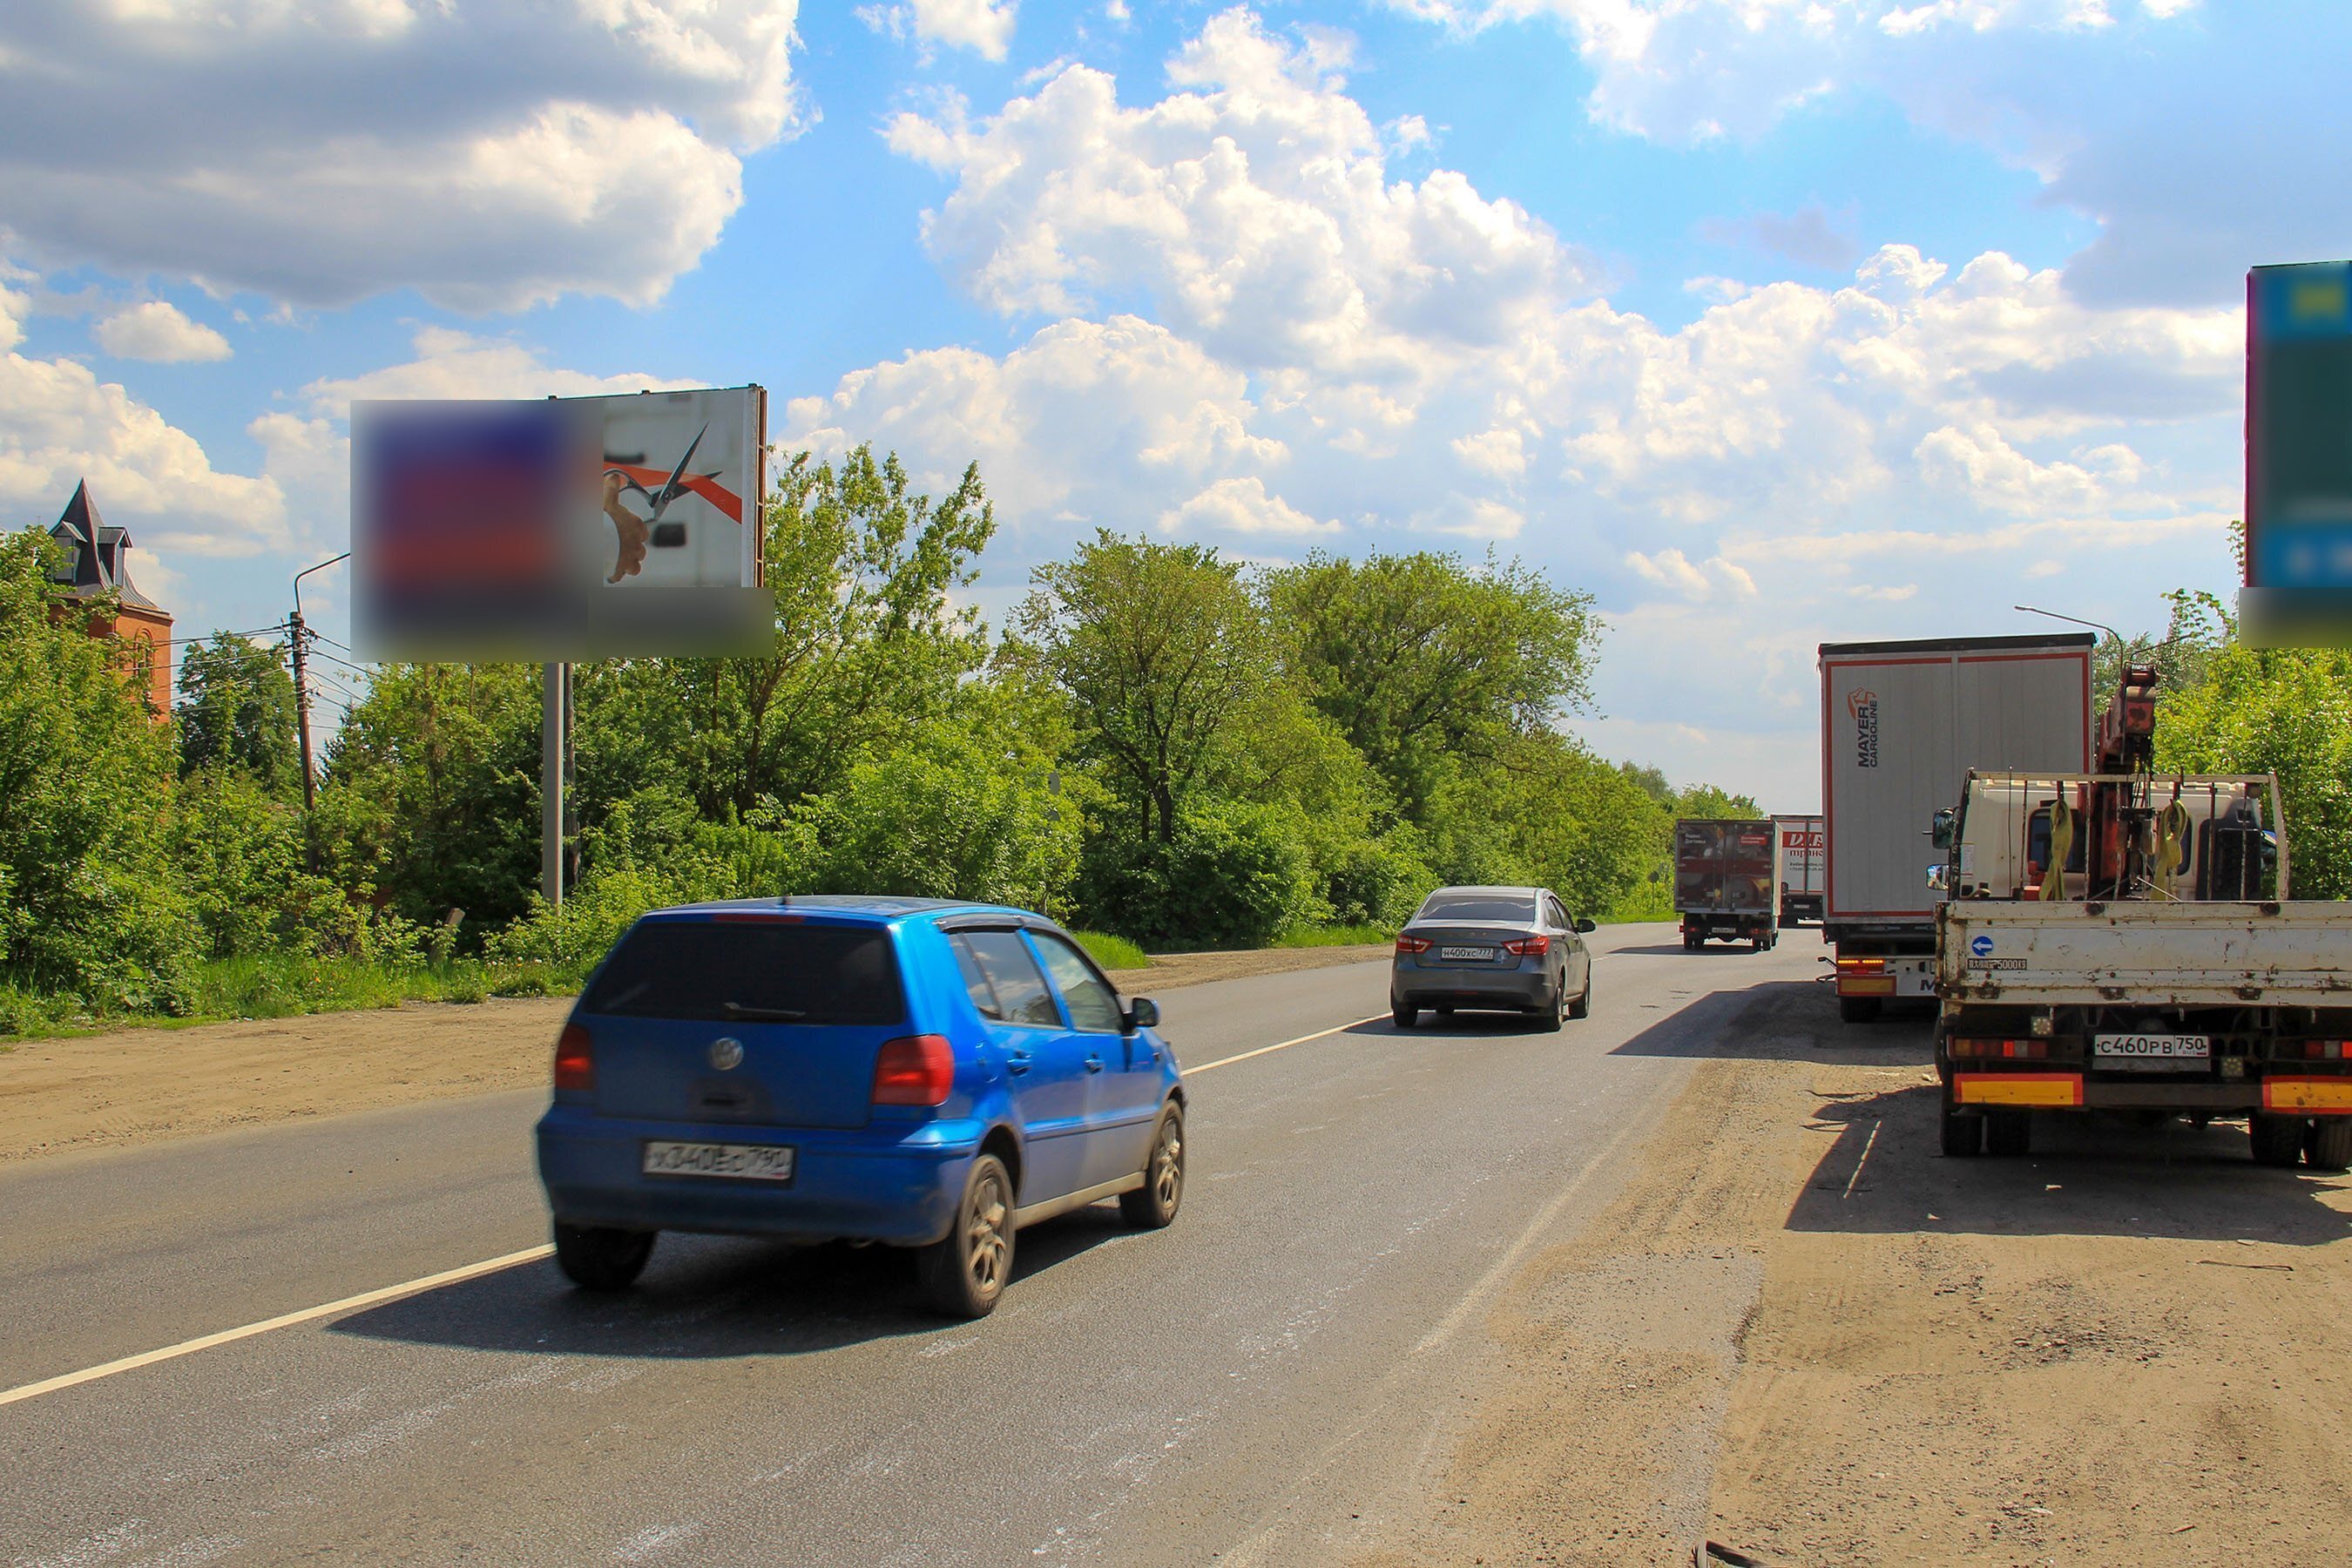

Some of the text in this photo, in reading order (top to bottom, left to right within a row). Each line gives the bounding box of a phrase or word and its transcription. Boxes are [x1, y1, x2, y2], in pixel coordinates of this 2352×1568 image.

[1857, 706, 1869, 767] MAYER
[2100, 1037, 2204, 1054] С460РВ 750
